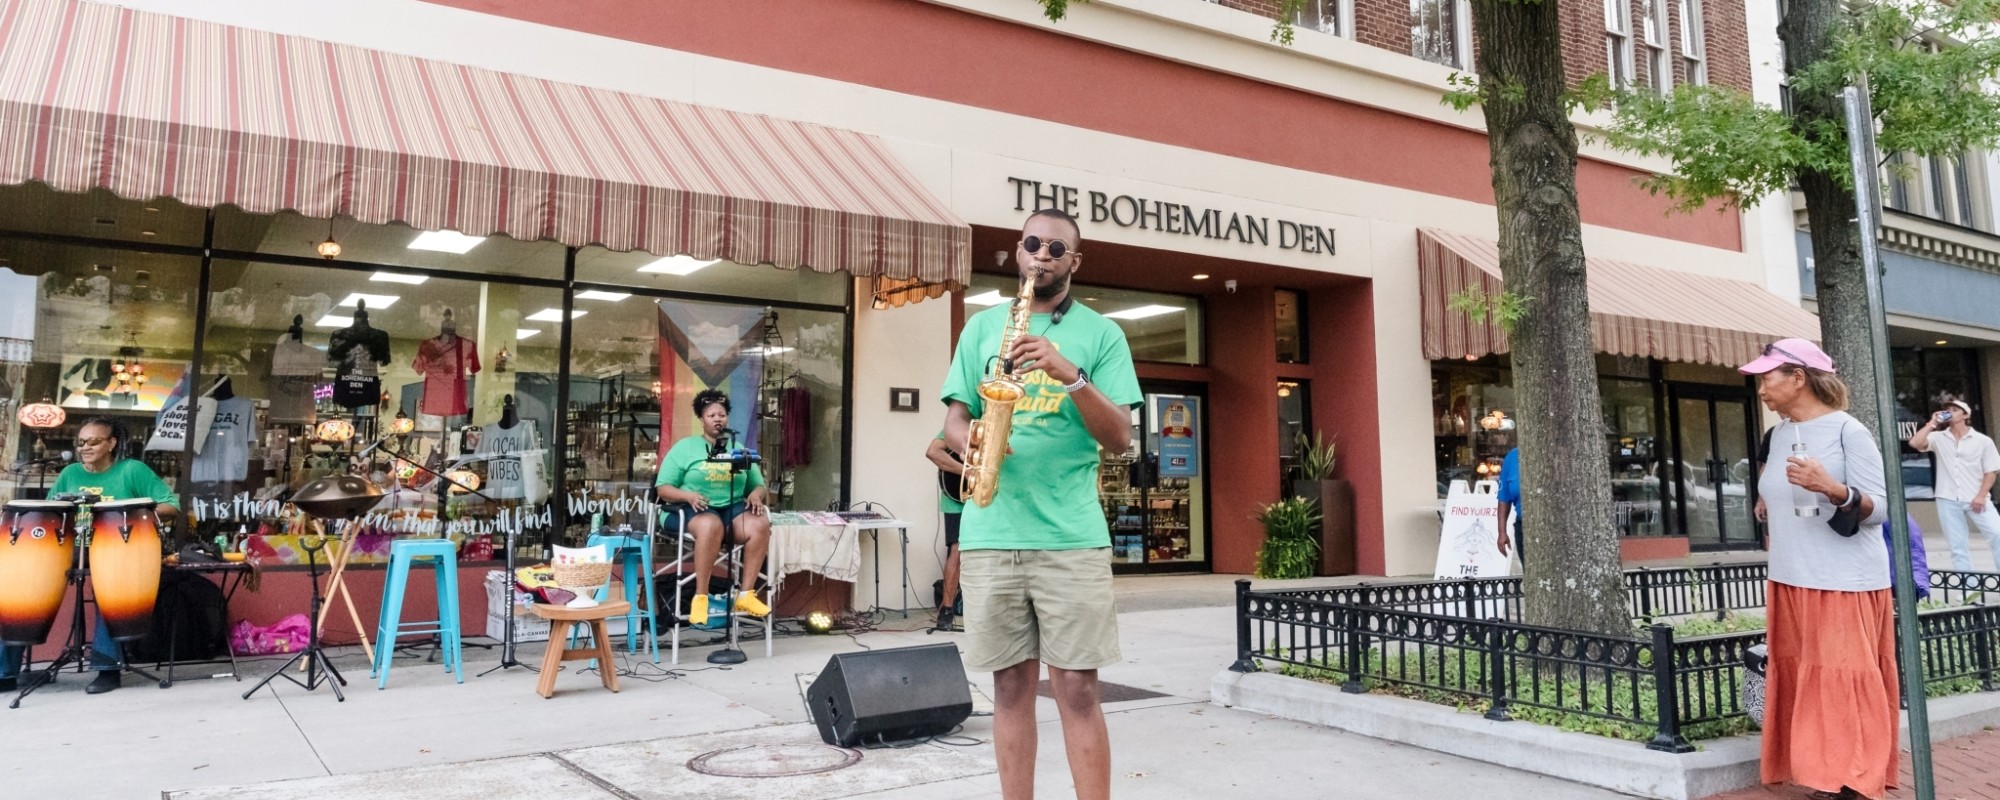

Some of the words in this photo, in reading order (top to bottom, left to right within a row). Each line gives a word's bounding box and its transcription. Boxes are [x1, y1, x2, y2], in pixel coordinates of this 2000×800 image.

[1008, 176, 1079, 219] THE
[1089, 190, 1269, 246] BOHEMIAN
[1278, 219, 1336, 256] DEN
[341, 375, 373, 383] BOHEMIAN
[1015, 387, 1067, 413] and
[162, 419, 187, 430] love
[489, 461, 520, 481] VIBES
[192, 496, 208, 522] It
[213, 498, 231, 519] is
[232, 490, 291, 522] then,
[402, 509, 440, 536] that
[479, 505, 510, 535] will
[514, 504, 553, 535] find
[567, 486, 653, 517] Wonderl
[1451, 506, 1469, 516] FIND
[1470, 507, 1491, 517] YOUR
[1459, 564, 1479, 575] THE
